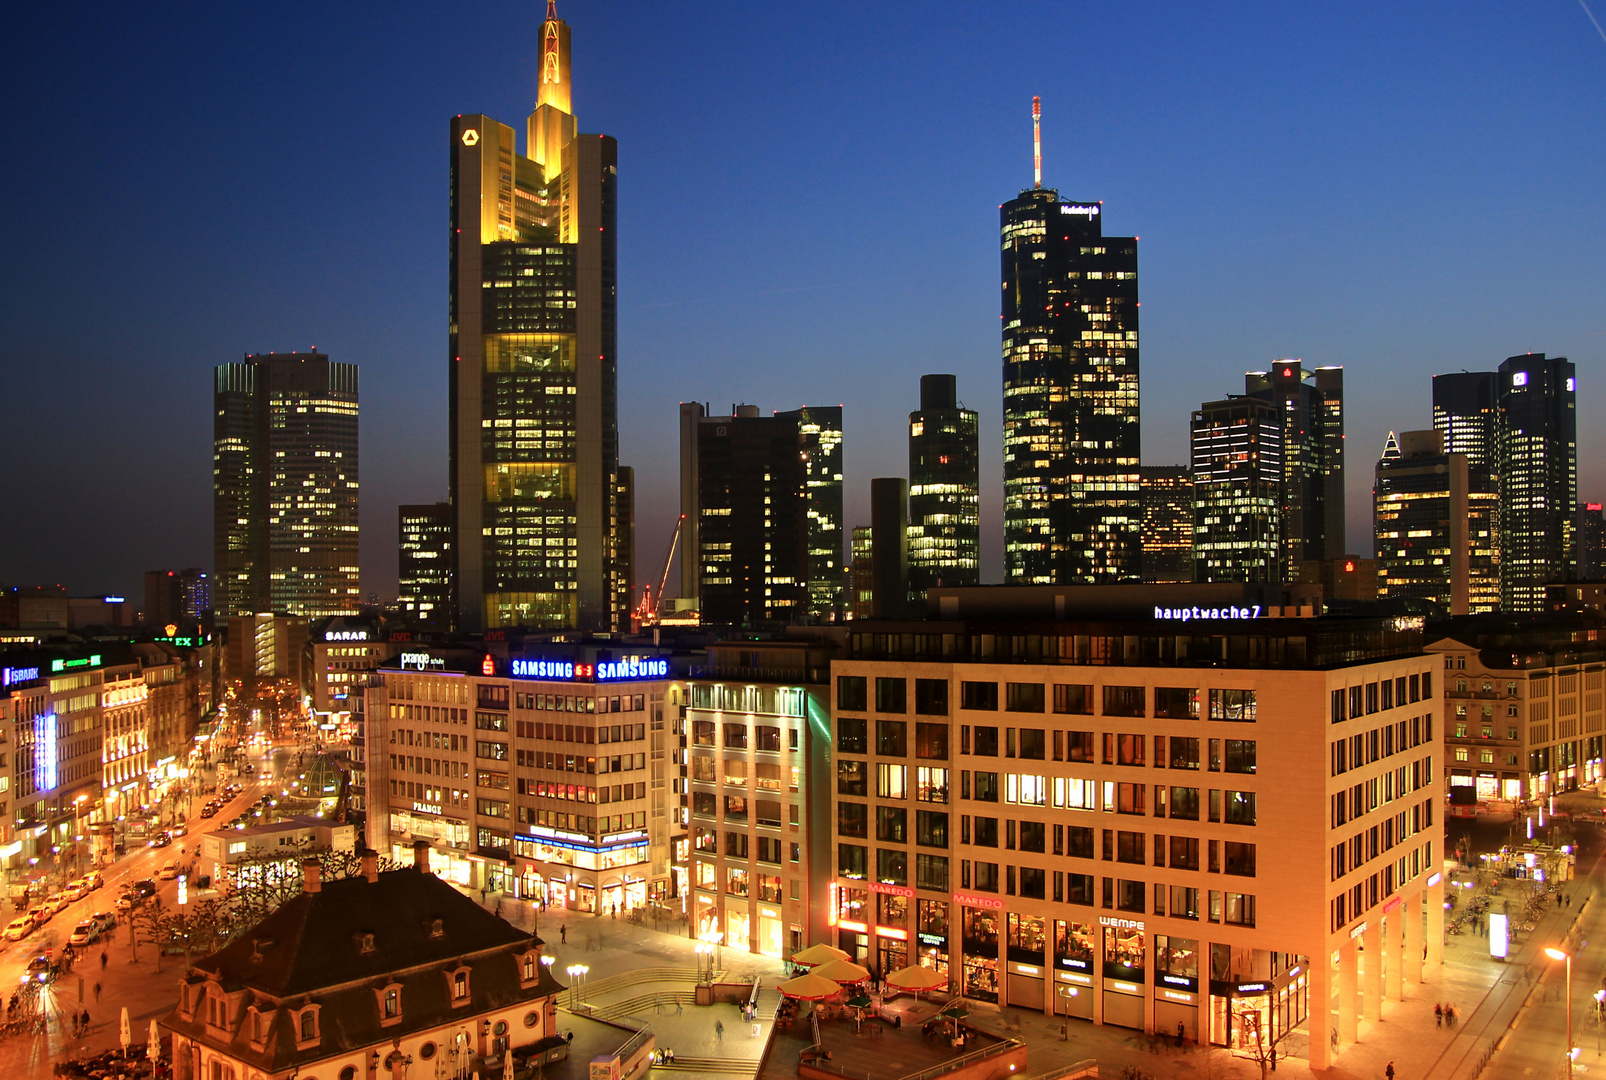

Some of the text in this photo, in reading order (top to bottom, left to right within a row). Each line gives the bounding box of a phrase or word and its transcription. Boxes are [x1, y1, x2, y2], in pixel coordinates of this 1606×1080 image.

[1154, 605, 1249, 622] hauptwache
[325, 631, 367, 641] SARAR
[389, 632, 411, 642] JVC
[484, 631, 505, 641] JVC
[401, 652, 430, 671] prange
[512, 660, 573, 678] SAMSUNG
[597, 660, 667, 679] SAMSUNG
[413, 802, 442, 815] PRANGE
[868, 883, 914, 898] MAREDO
[953, 893, 1003, 909] MAREDO
[1099, 916, 1145, 930] WEMPE
